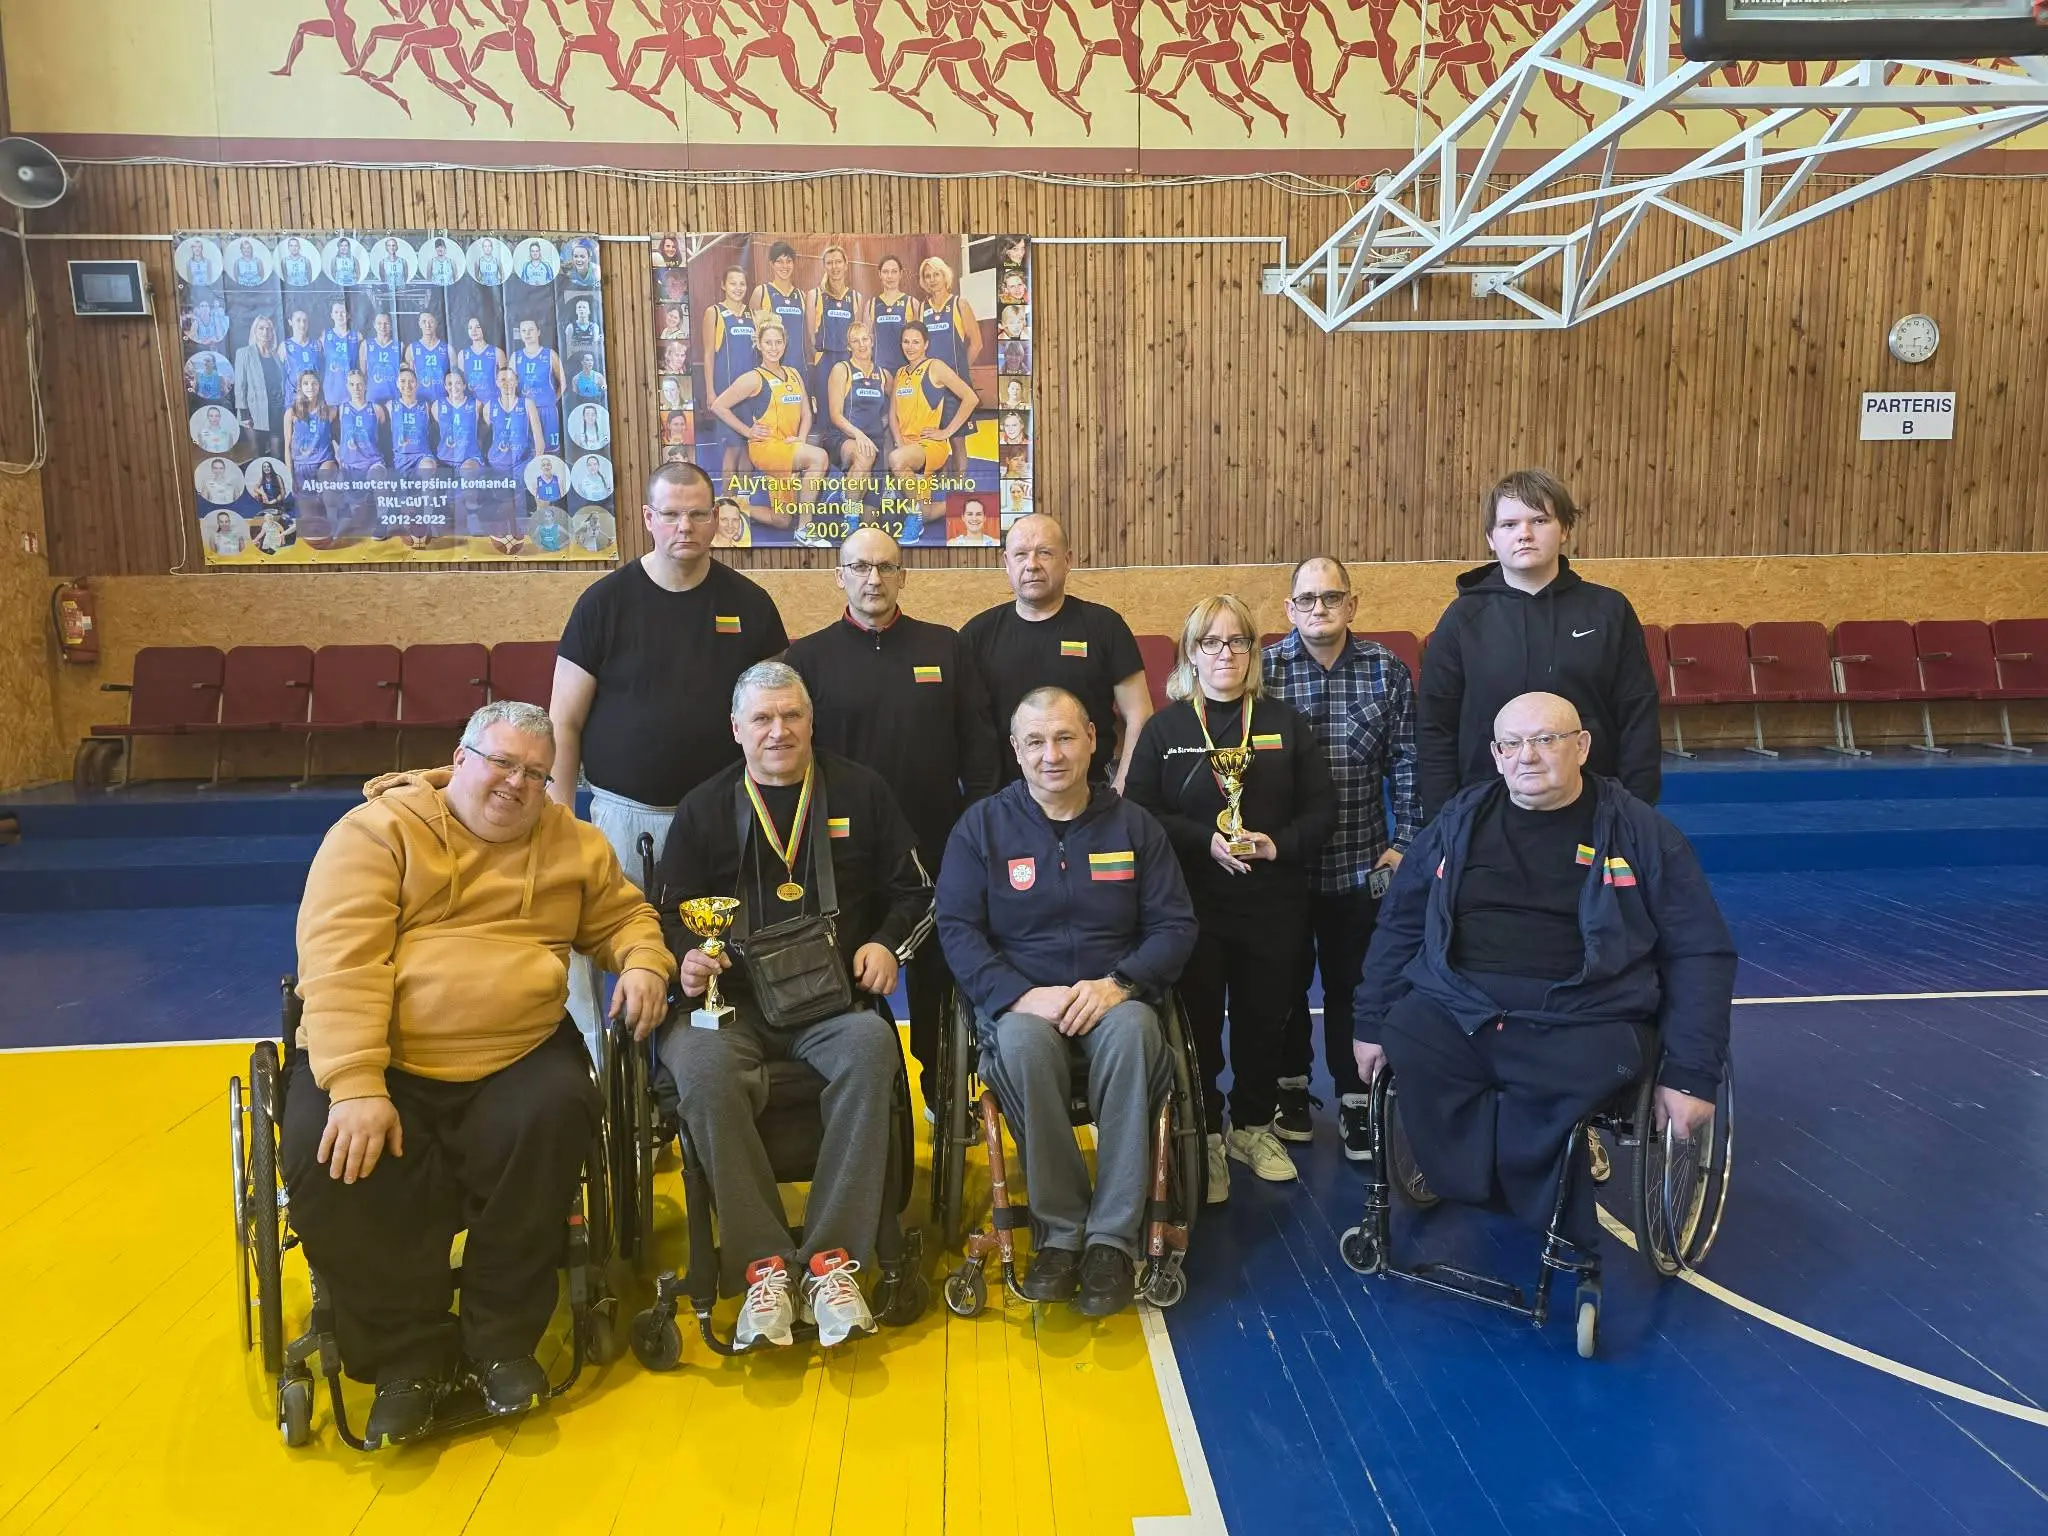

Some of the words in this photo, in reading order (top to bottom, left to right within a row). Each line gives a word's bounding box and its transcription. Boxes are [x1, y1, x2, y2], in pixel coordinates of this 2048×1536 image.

[335, 341, 348, 352] 24
[378, 352, 389, 363] 12
[425, 354, 437, 366] 23
[472, 359, 483, 371] 11
[525, 362, 536, 374] 17
[1866, 398, 1952, 413] PARTERIS
[355, 414, 363, 427] 6
[403, 412, 416, 425] 15
[504, 416, 512, 430] 7
[309, 420, 317, 433] 5
[1902, 420, 1914, 435] B
[302, 479, 350, 493] Alytaus
[352, 480, 398, 493] moterų
[400, 478, 459, 491] krepšinio
[460, 478, 517, 490] komanda
[727, 475, 803, 495] Alytaus
[809, 477, 879, 494] moterų
[885, 473, 976, 492] krepšinio
[377, 495, 448, 508] RKL-GUT.LT
[774, 498, 865, 515] komanda
[380, 514, 447, 525] 2012-2022
[805, 521, 904, 538] 200212
